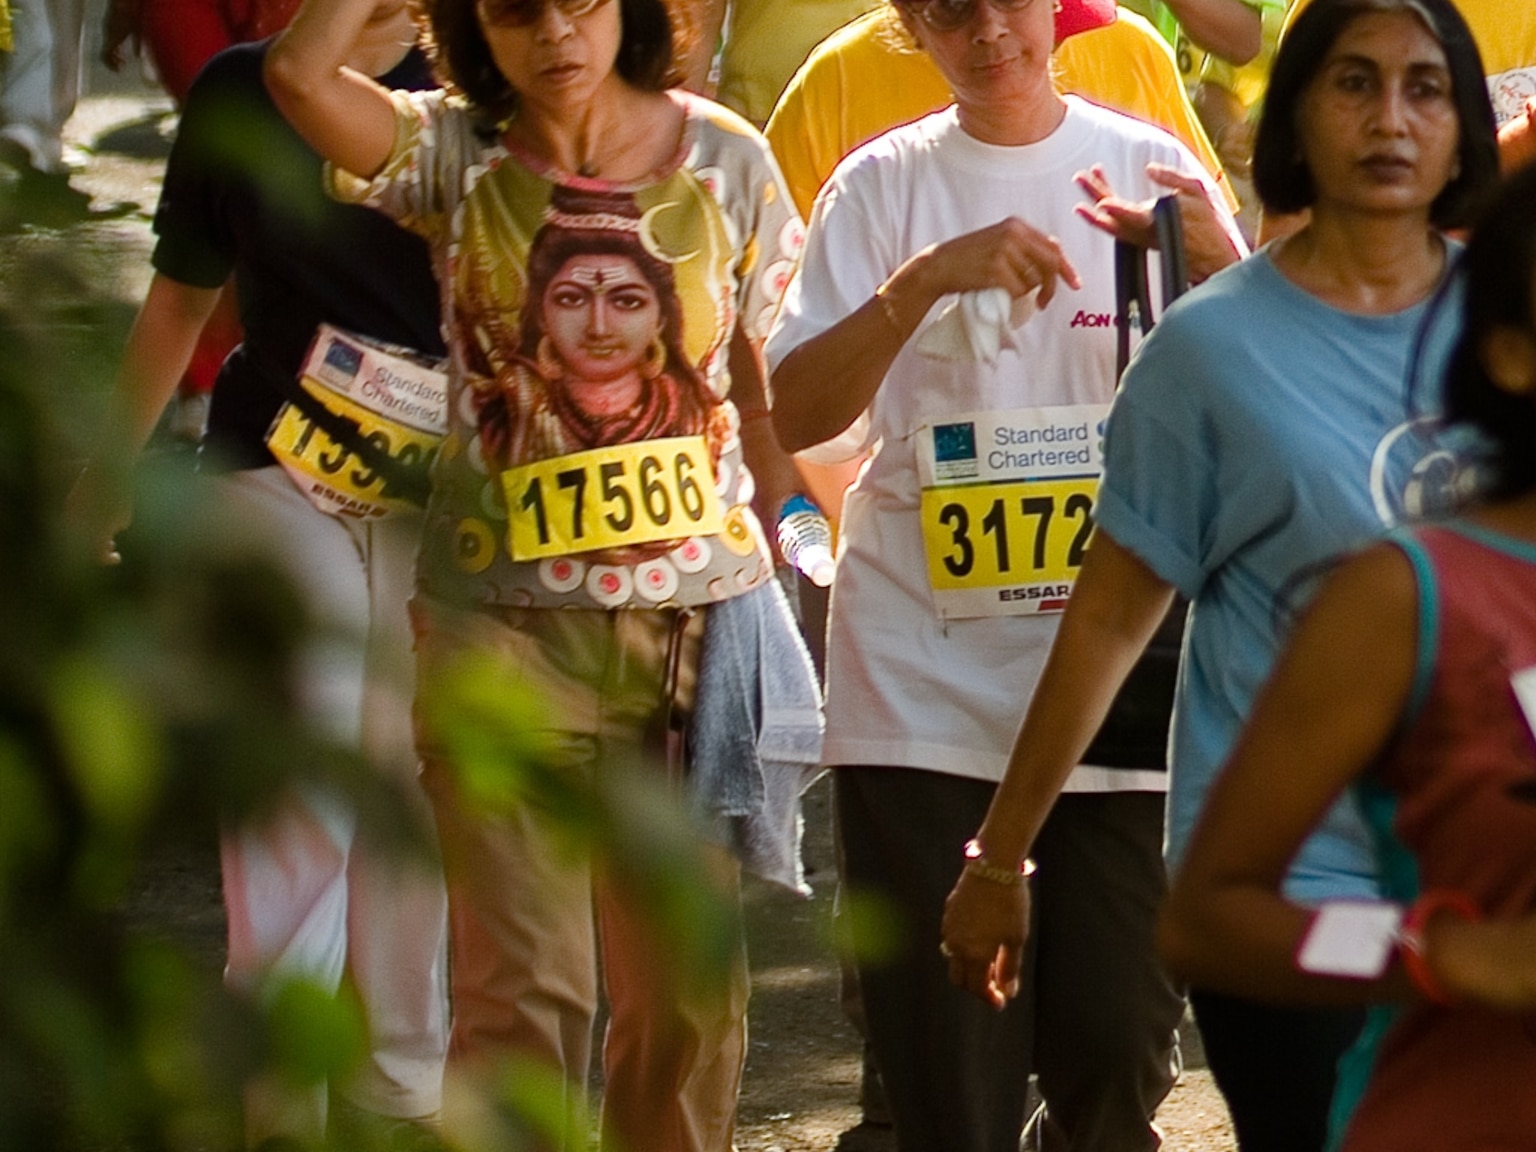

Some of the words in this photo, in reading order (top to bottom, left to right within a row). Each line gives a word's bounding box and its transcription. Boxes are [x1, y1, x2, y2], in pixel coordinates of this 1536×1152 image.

[1070, 310, 1111, 328] AON
[361, 379, 441, 424] Chartered
[994, 423, 1089, 446] Standard
[988, 446, 1091, 470] Chartered
[521, 452, 705, 545] 17566
[998, 585, 1070, 602] ESSAR
